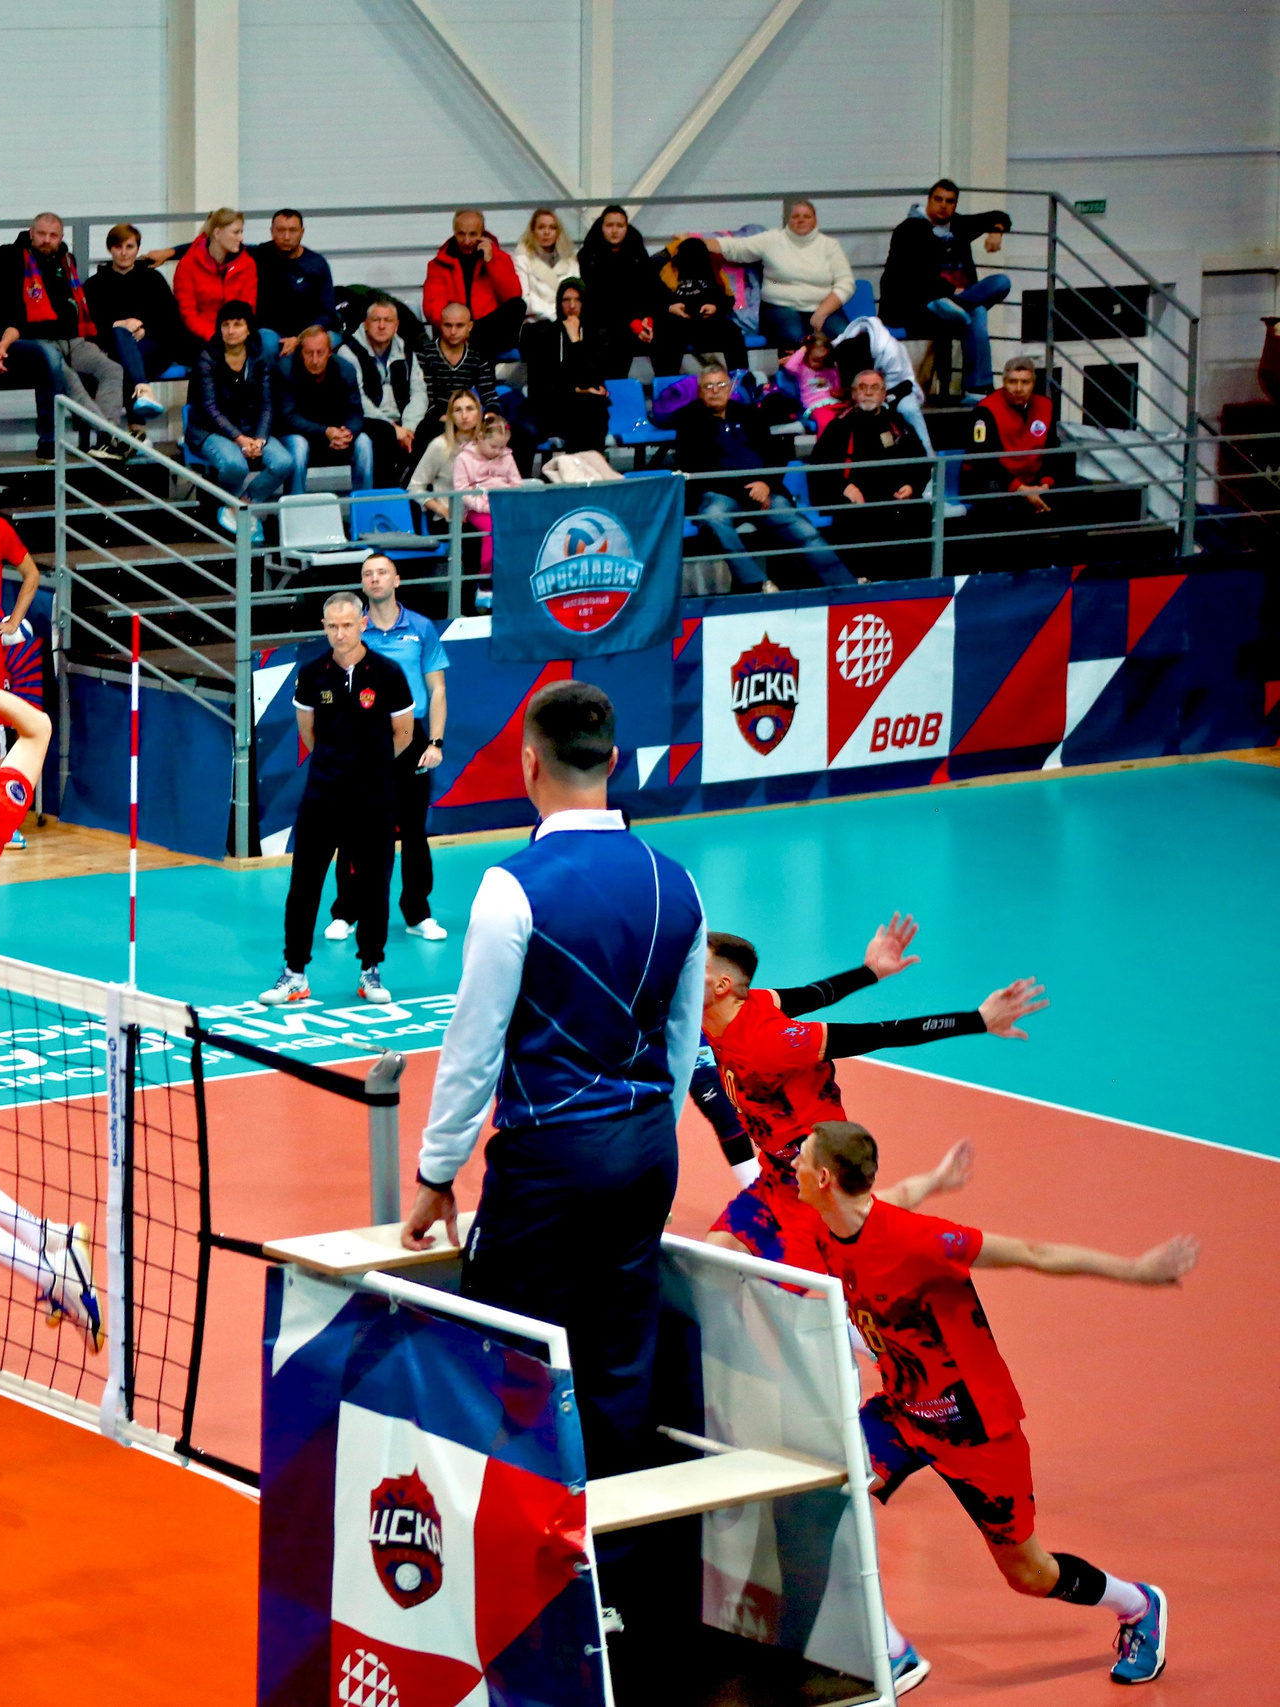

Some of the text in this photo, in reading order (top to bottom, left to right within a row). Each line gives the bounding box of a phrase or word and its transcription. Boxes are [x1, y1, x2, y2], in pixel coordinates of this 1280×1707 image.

[535, 559, 639, 596] ЯРОСЛАВИЧ
[731, 671, 799, 711] ЦСКА
[869, 711, 943, 753] ВФВ
[369, 1508, 443, 1562] ЦСКА
